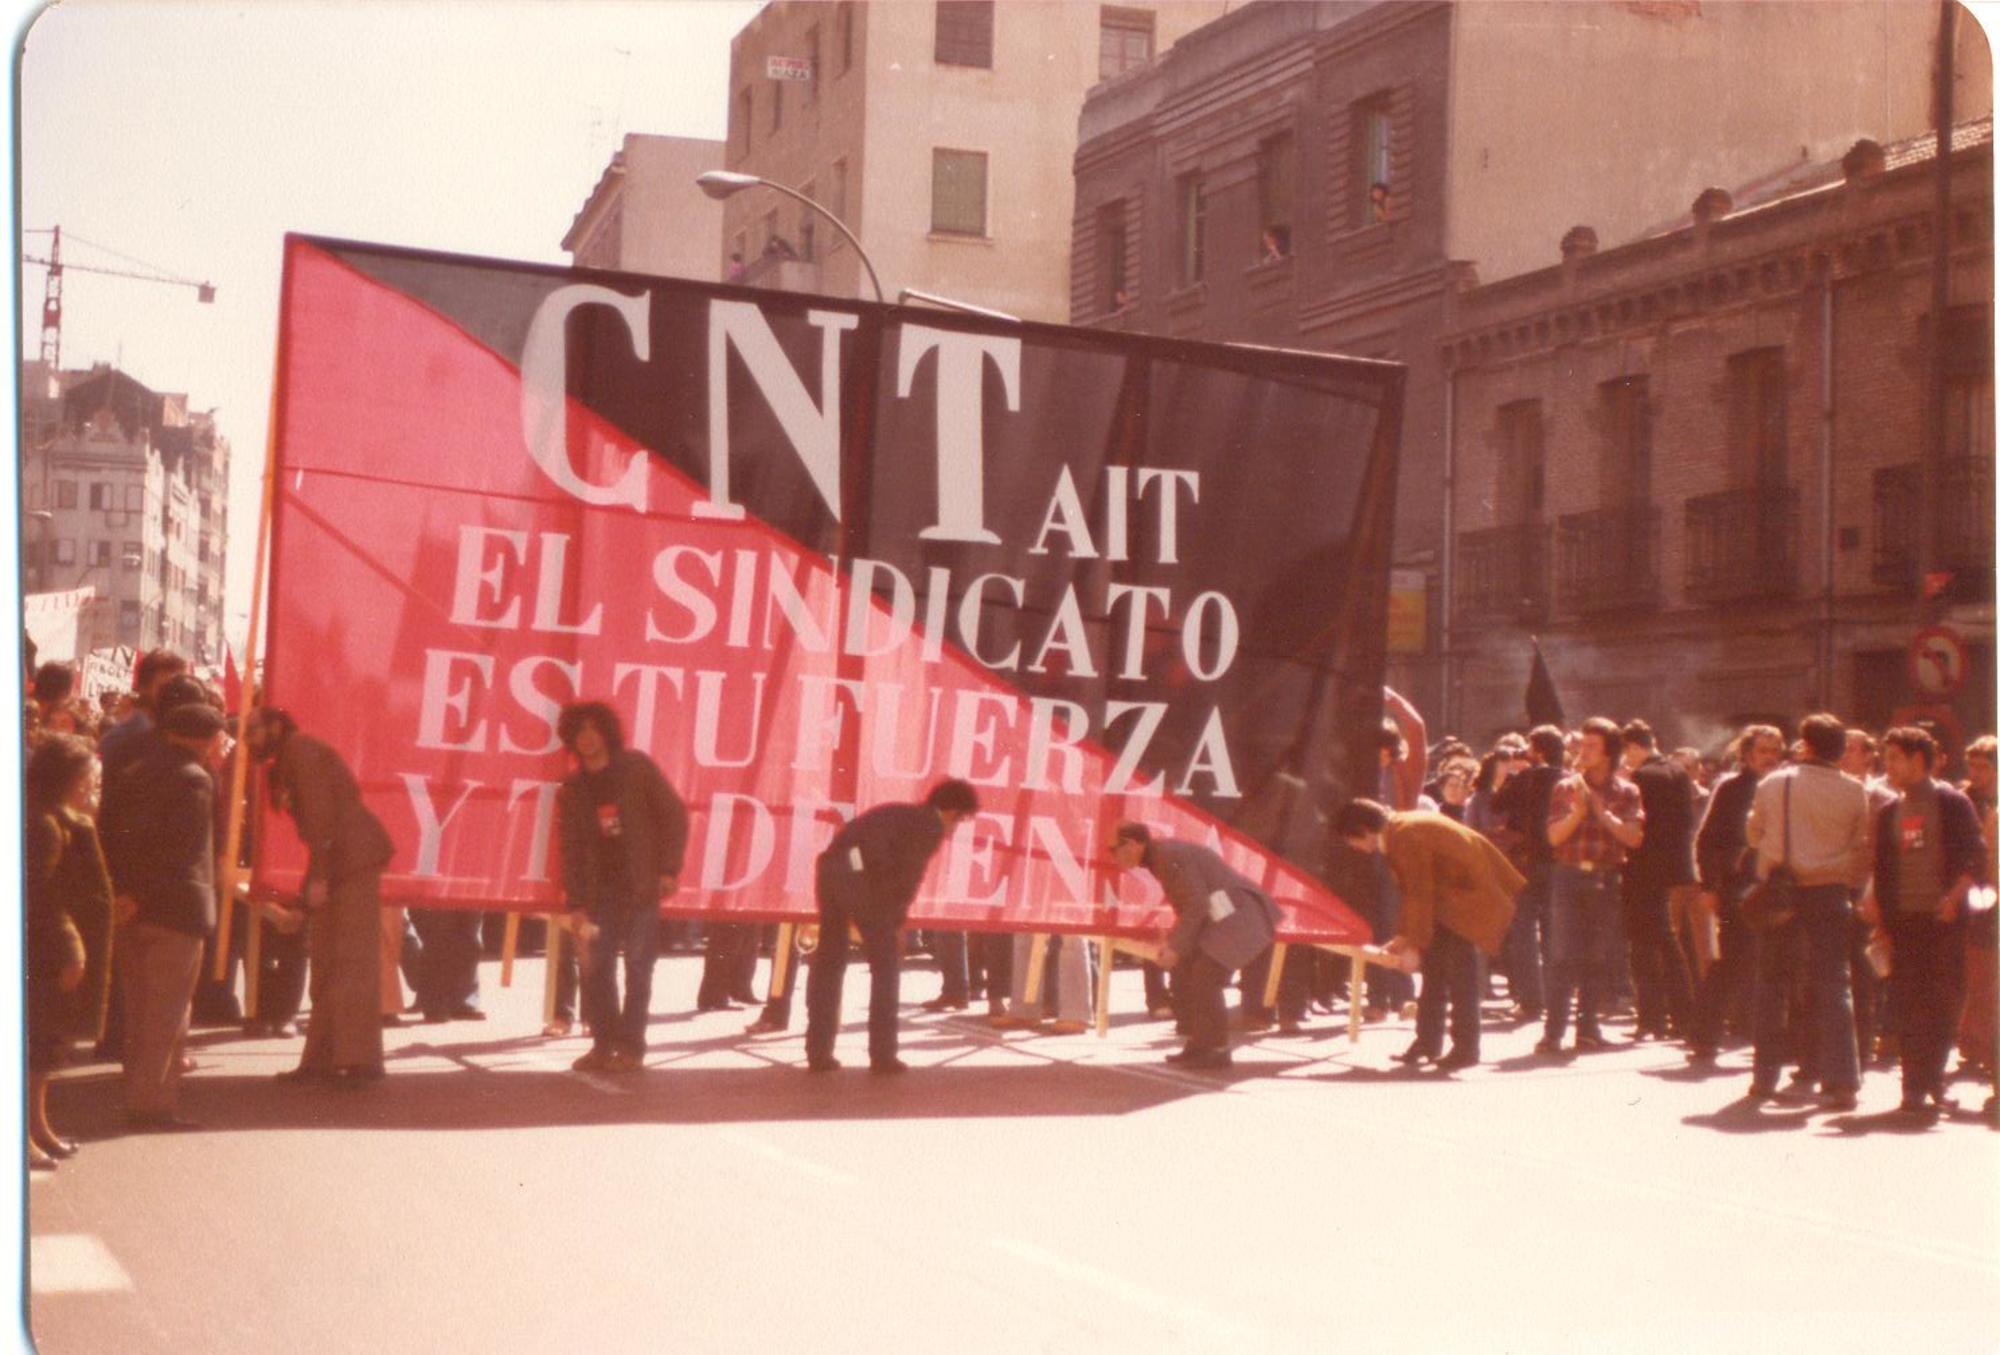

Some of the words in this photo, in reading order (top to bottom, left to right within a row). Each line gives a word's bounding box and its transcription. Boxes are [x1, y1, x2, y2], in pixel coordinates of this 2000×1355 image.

[520, 282, 1022, 545] CNT
[1027, 462, 1200, 564] AIT
[448, 524, 603, 636] EL
[644, 543, 1240, 683] SINDICATO
[415, 648, 582, 756] ES
[612, 662, 767, 769] TU
[790, 673, 1242, 799] FUERZA
[397, 772, 485, 877] Y
[702, 791, 1224, 909] DEEN
